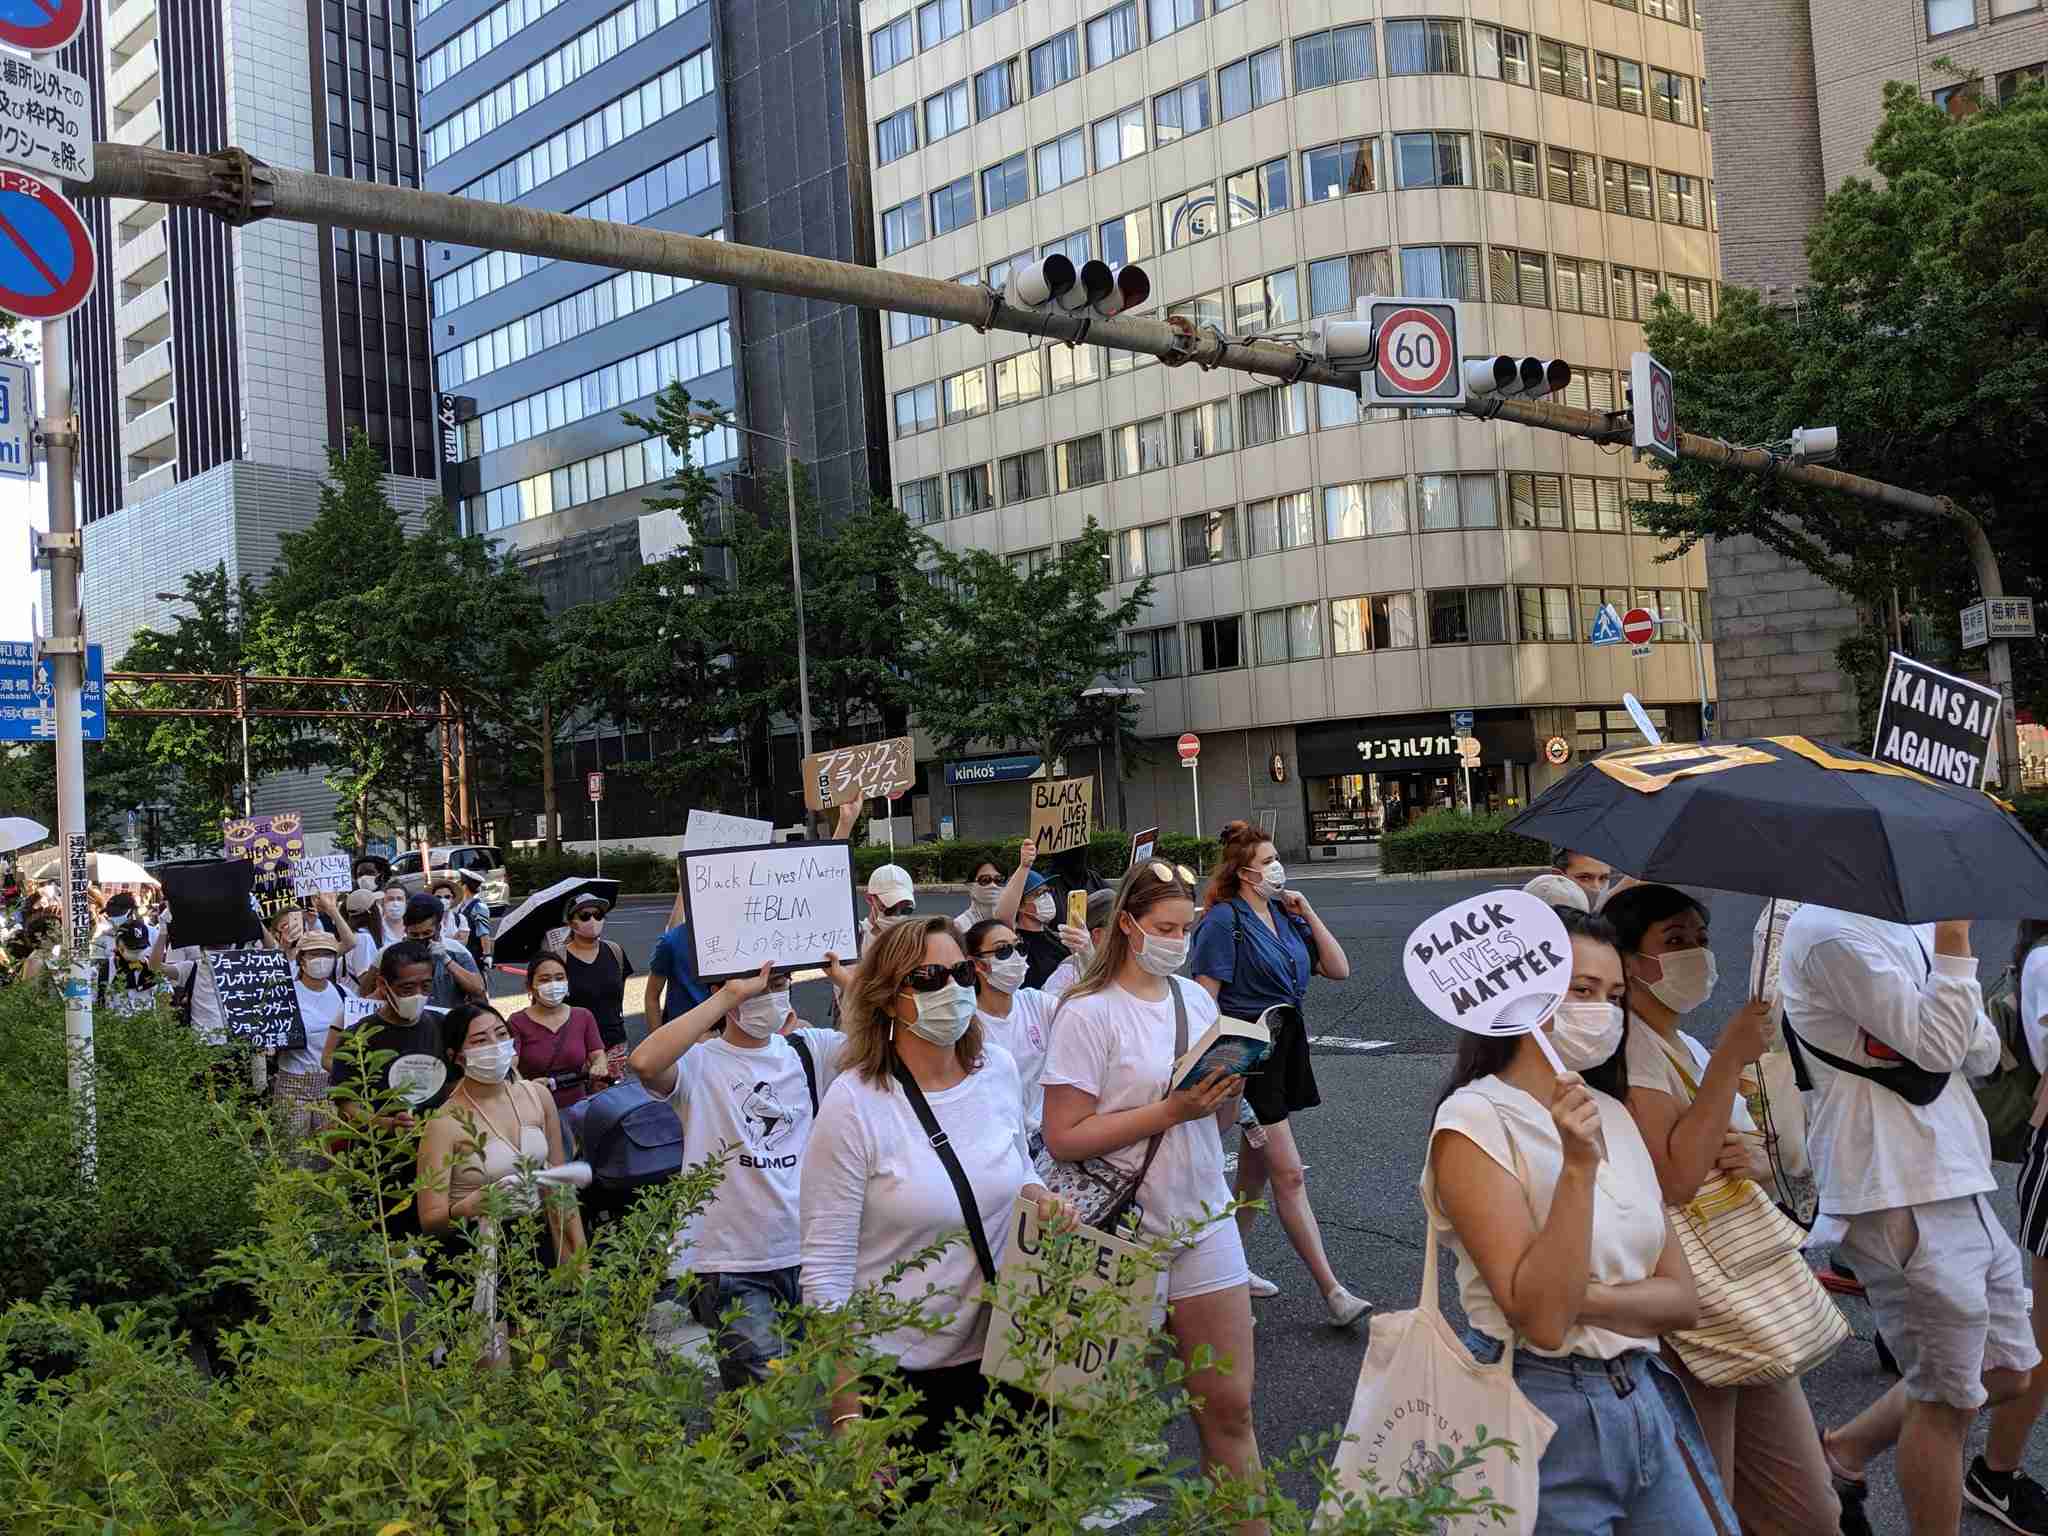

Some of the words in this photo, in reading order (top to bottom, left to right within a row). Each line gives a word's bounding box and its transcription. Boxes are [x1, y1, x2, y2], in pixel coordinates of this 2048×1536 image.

[0, 57, 84, 107] 場所以外での
[0, 124, 88, 177] クシーを除く
[1395, 333, 1435, 368] 60
[1656, 391, 1668, 423] 60
[37, 684, 50, 694] 25
[1891, 669, 1992, 738] KANSAI
[1357, 736, 1460, 760] サンマルクカフ
[1883, 726, 1979, 788] AGAINST
[1035, 783, 1083, 808] BLACK
[1063, 802, 1088, 825] LIVES
[1035, 822, 1089, 851] MATTER
[295, 875, 350, 892] MATTER
[694, 863, 742, 892] Black
[749, 861, 795, 887] Lives
[800, 855, 847, 881] Matter
[744, 894, 812, 922] #BLM
[1411, 903, 1515, 965] BLACK
[1428, 930, 1527, 993] LIVES
[1450, 940, 1564, 1016] MATTER
[739, 1154, 797, 1168] SUMO
